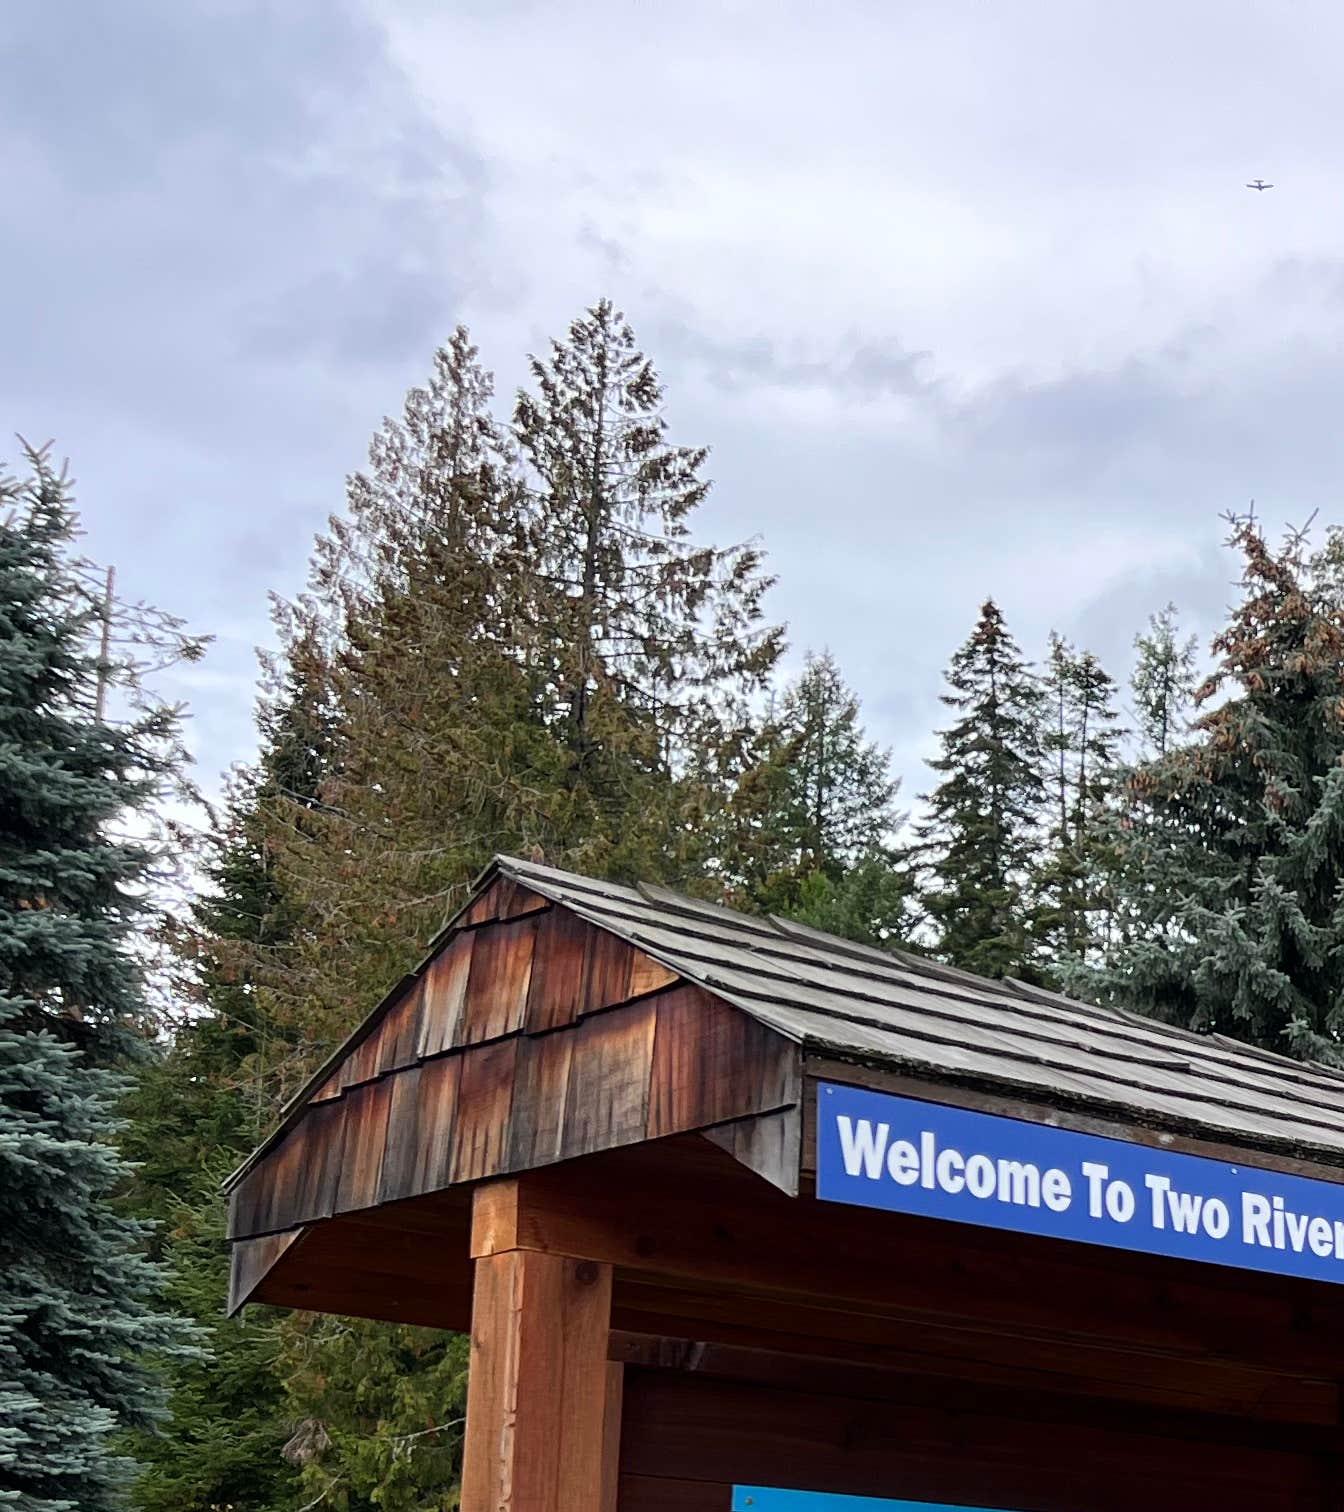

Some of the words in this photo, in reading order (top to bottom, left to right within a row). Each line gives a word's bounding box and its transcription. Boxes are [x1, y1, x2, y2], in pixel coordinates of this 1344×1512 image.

[836, 1115, 1071, 1211] Welcome
[1081, 1161, 1135, 1222] To
[1145, 1172, 1229, 1239] Two
